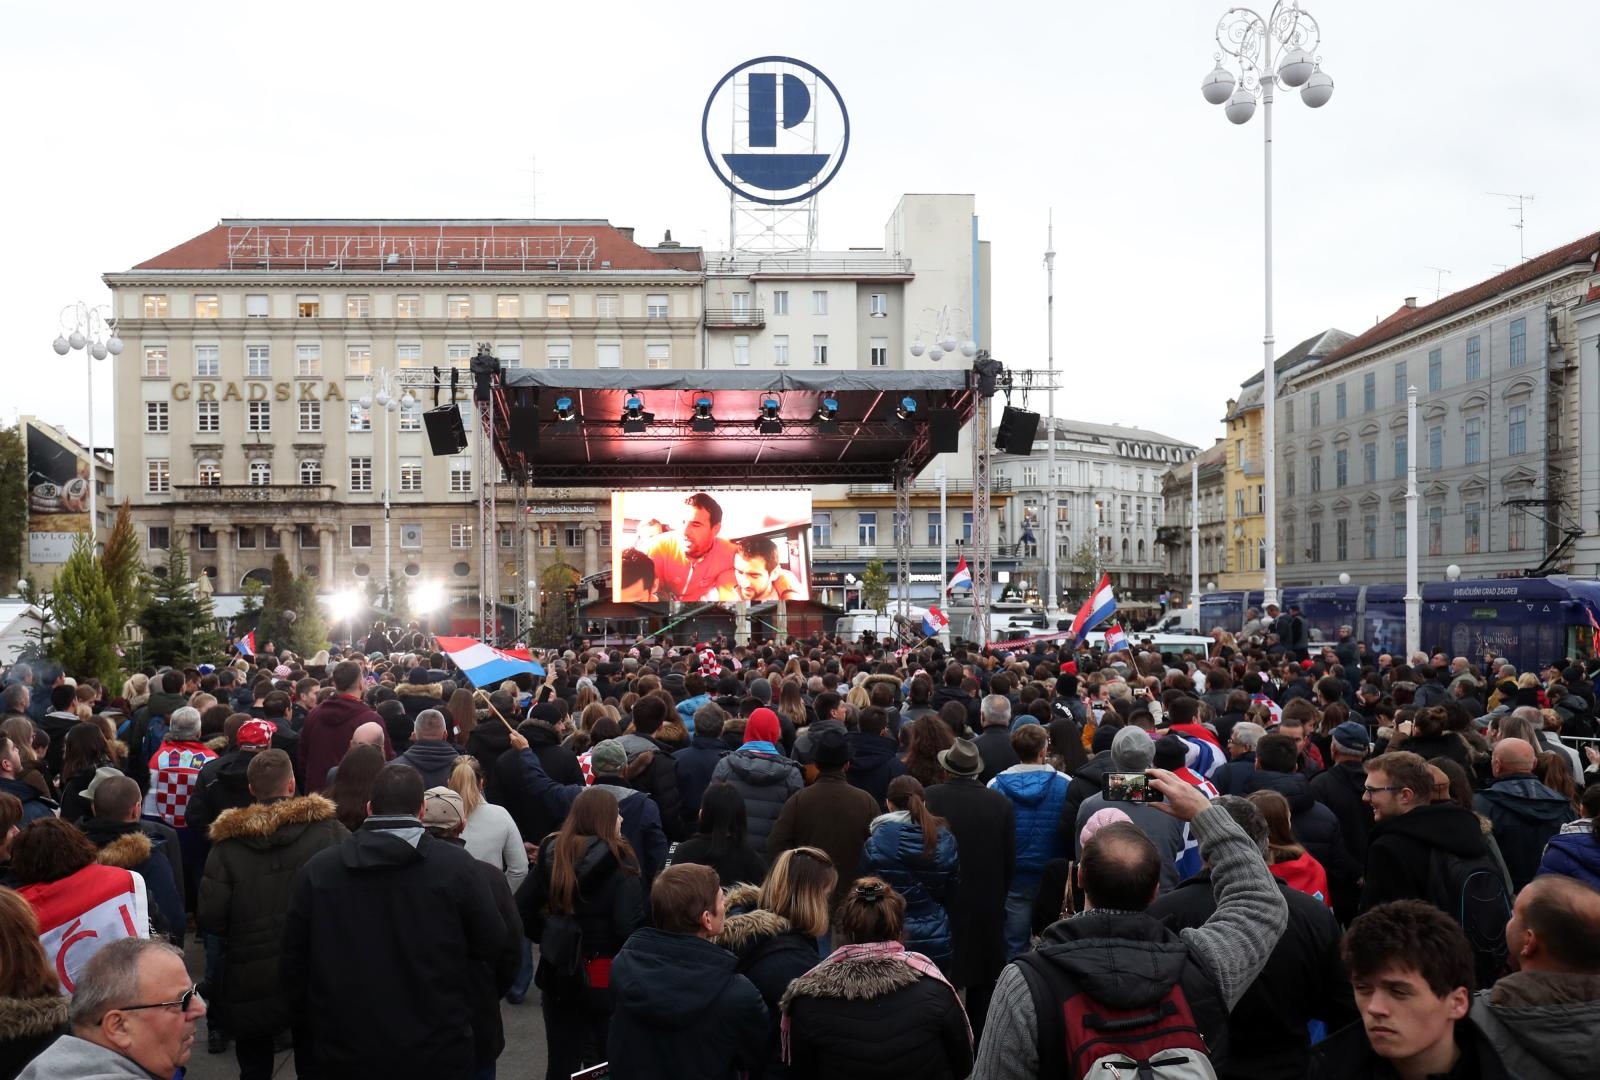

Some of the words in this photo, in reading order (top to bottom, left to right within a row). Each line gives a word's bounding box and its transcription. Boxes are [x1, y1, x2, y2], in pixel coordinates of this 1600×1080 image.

[748, 73, 811, 147] P
[171, 382, 344, 402] GRADSKA
[532, 505, 572, 515] Zagrebačka
[573, 505, 595, 513] banka
[1481, 587, 1496, 595] GRAD
[1496, 587, 1518, 595] ZAGREB
